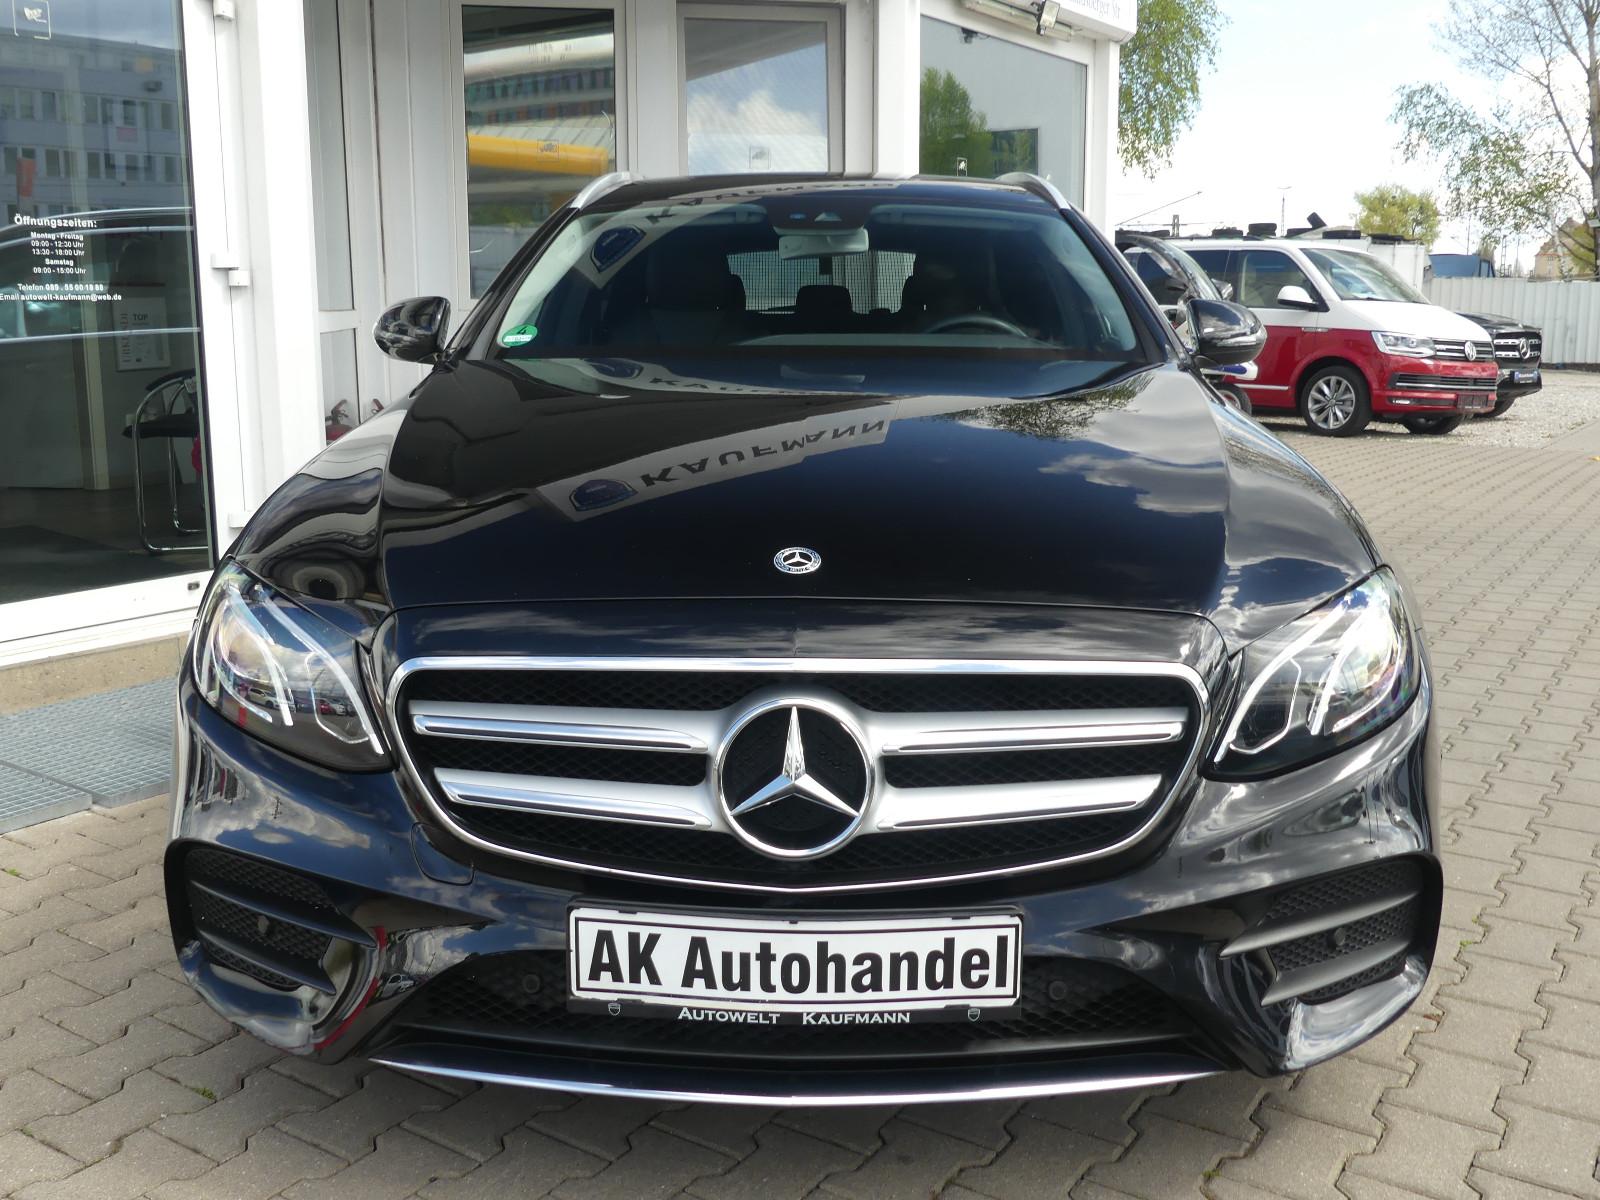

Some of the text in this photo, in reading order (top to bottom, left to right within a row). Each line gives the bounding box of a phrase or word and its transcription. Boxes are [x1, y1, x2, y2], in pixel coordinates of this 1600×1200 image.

[14, 213, 97, 229] Öffnungszeiten:
[30, 231, 56, 240] Montag
[60, 233, 84, 241] Freitag
[45, 258, 74, 266] Samstag
[17, 283, 44, 291] Telefon
[587, 928, 1010, 994] AK Autohandel
